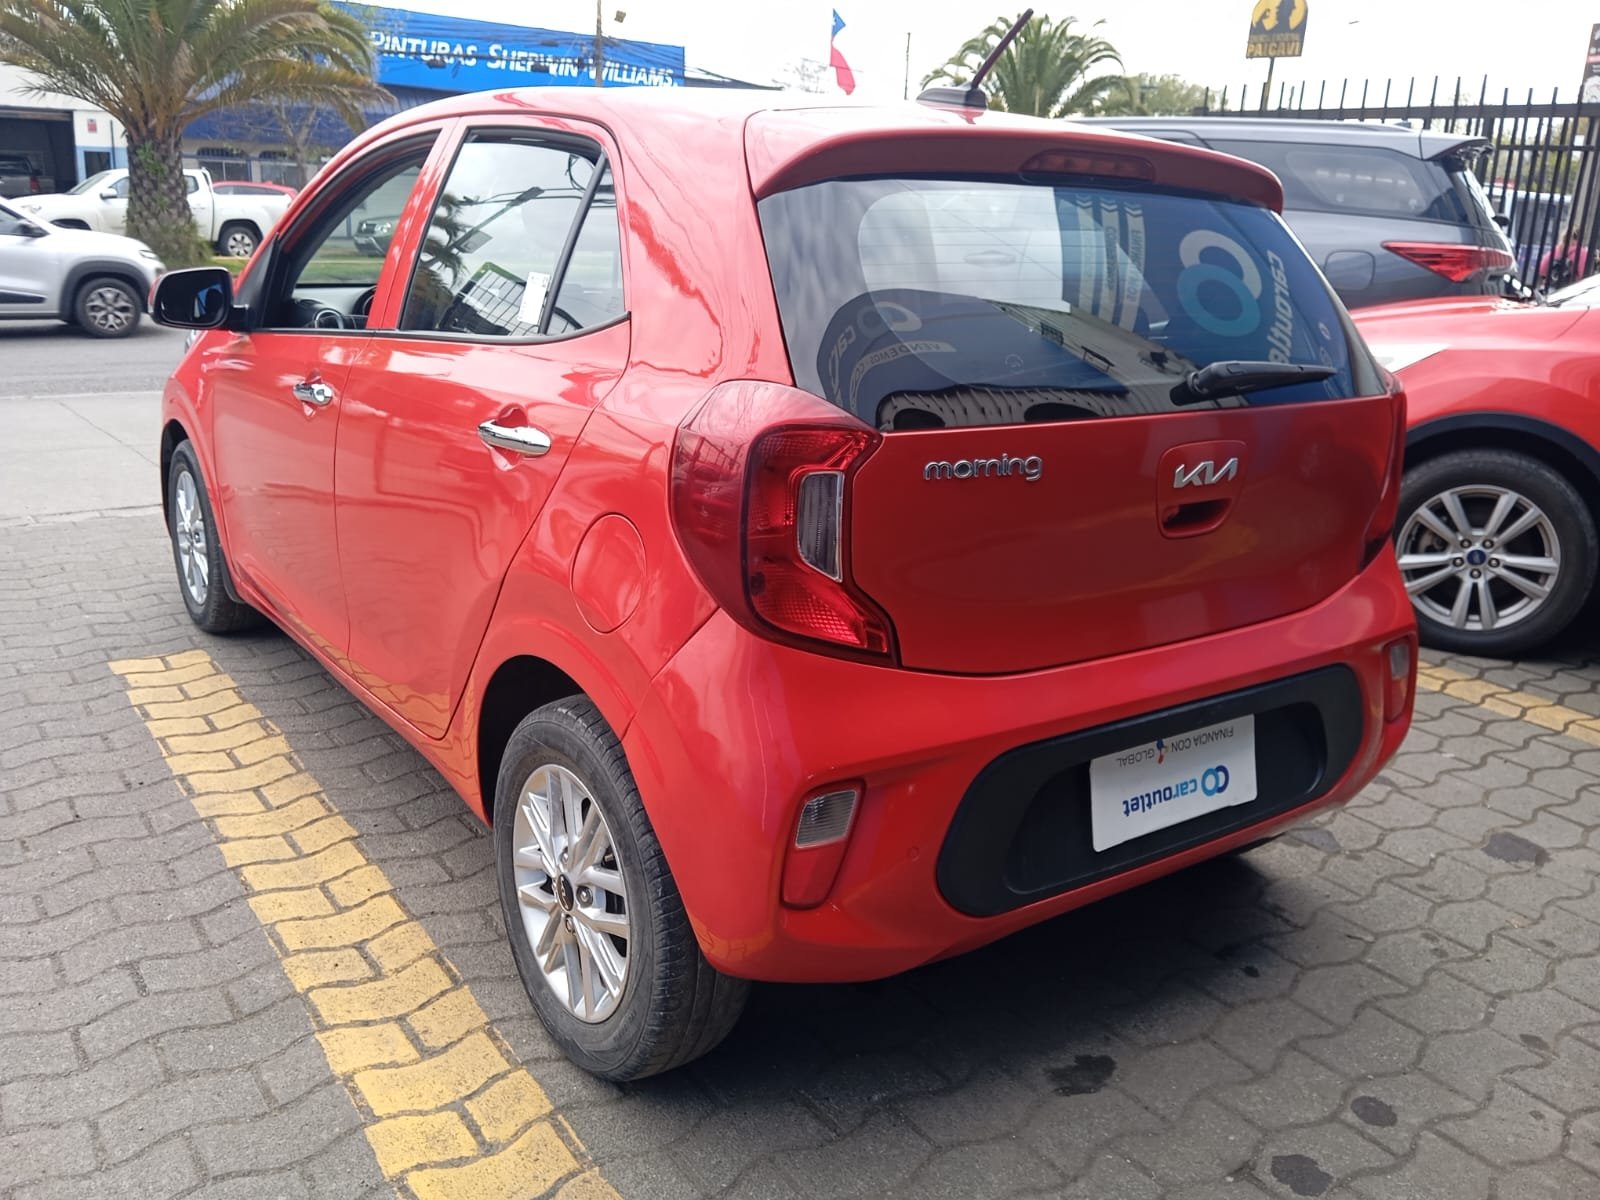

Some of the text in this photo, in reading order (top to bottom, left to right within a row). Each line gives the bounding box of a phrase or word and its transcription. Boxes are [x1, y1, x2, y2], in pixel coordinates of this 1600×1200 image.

[370, 31, 478, 67] PINTURAS
[923, 453, 1043, 482] morning
[1173, 457, 1238, 489] KIA
[1116, 726, 1235, 768] FINANCIA CON GLOBAL
[1122, 778, 1198, 817] caroutlet
